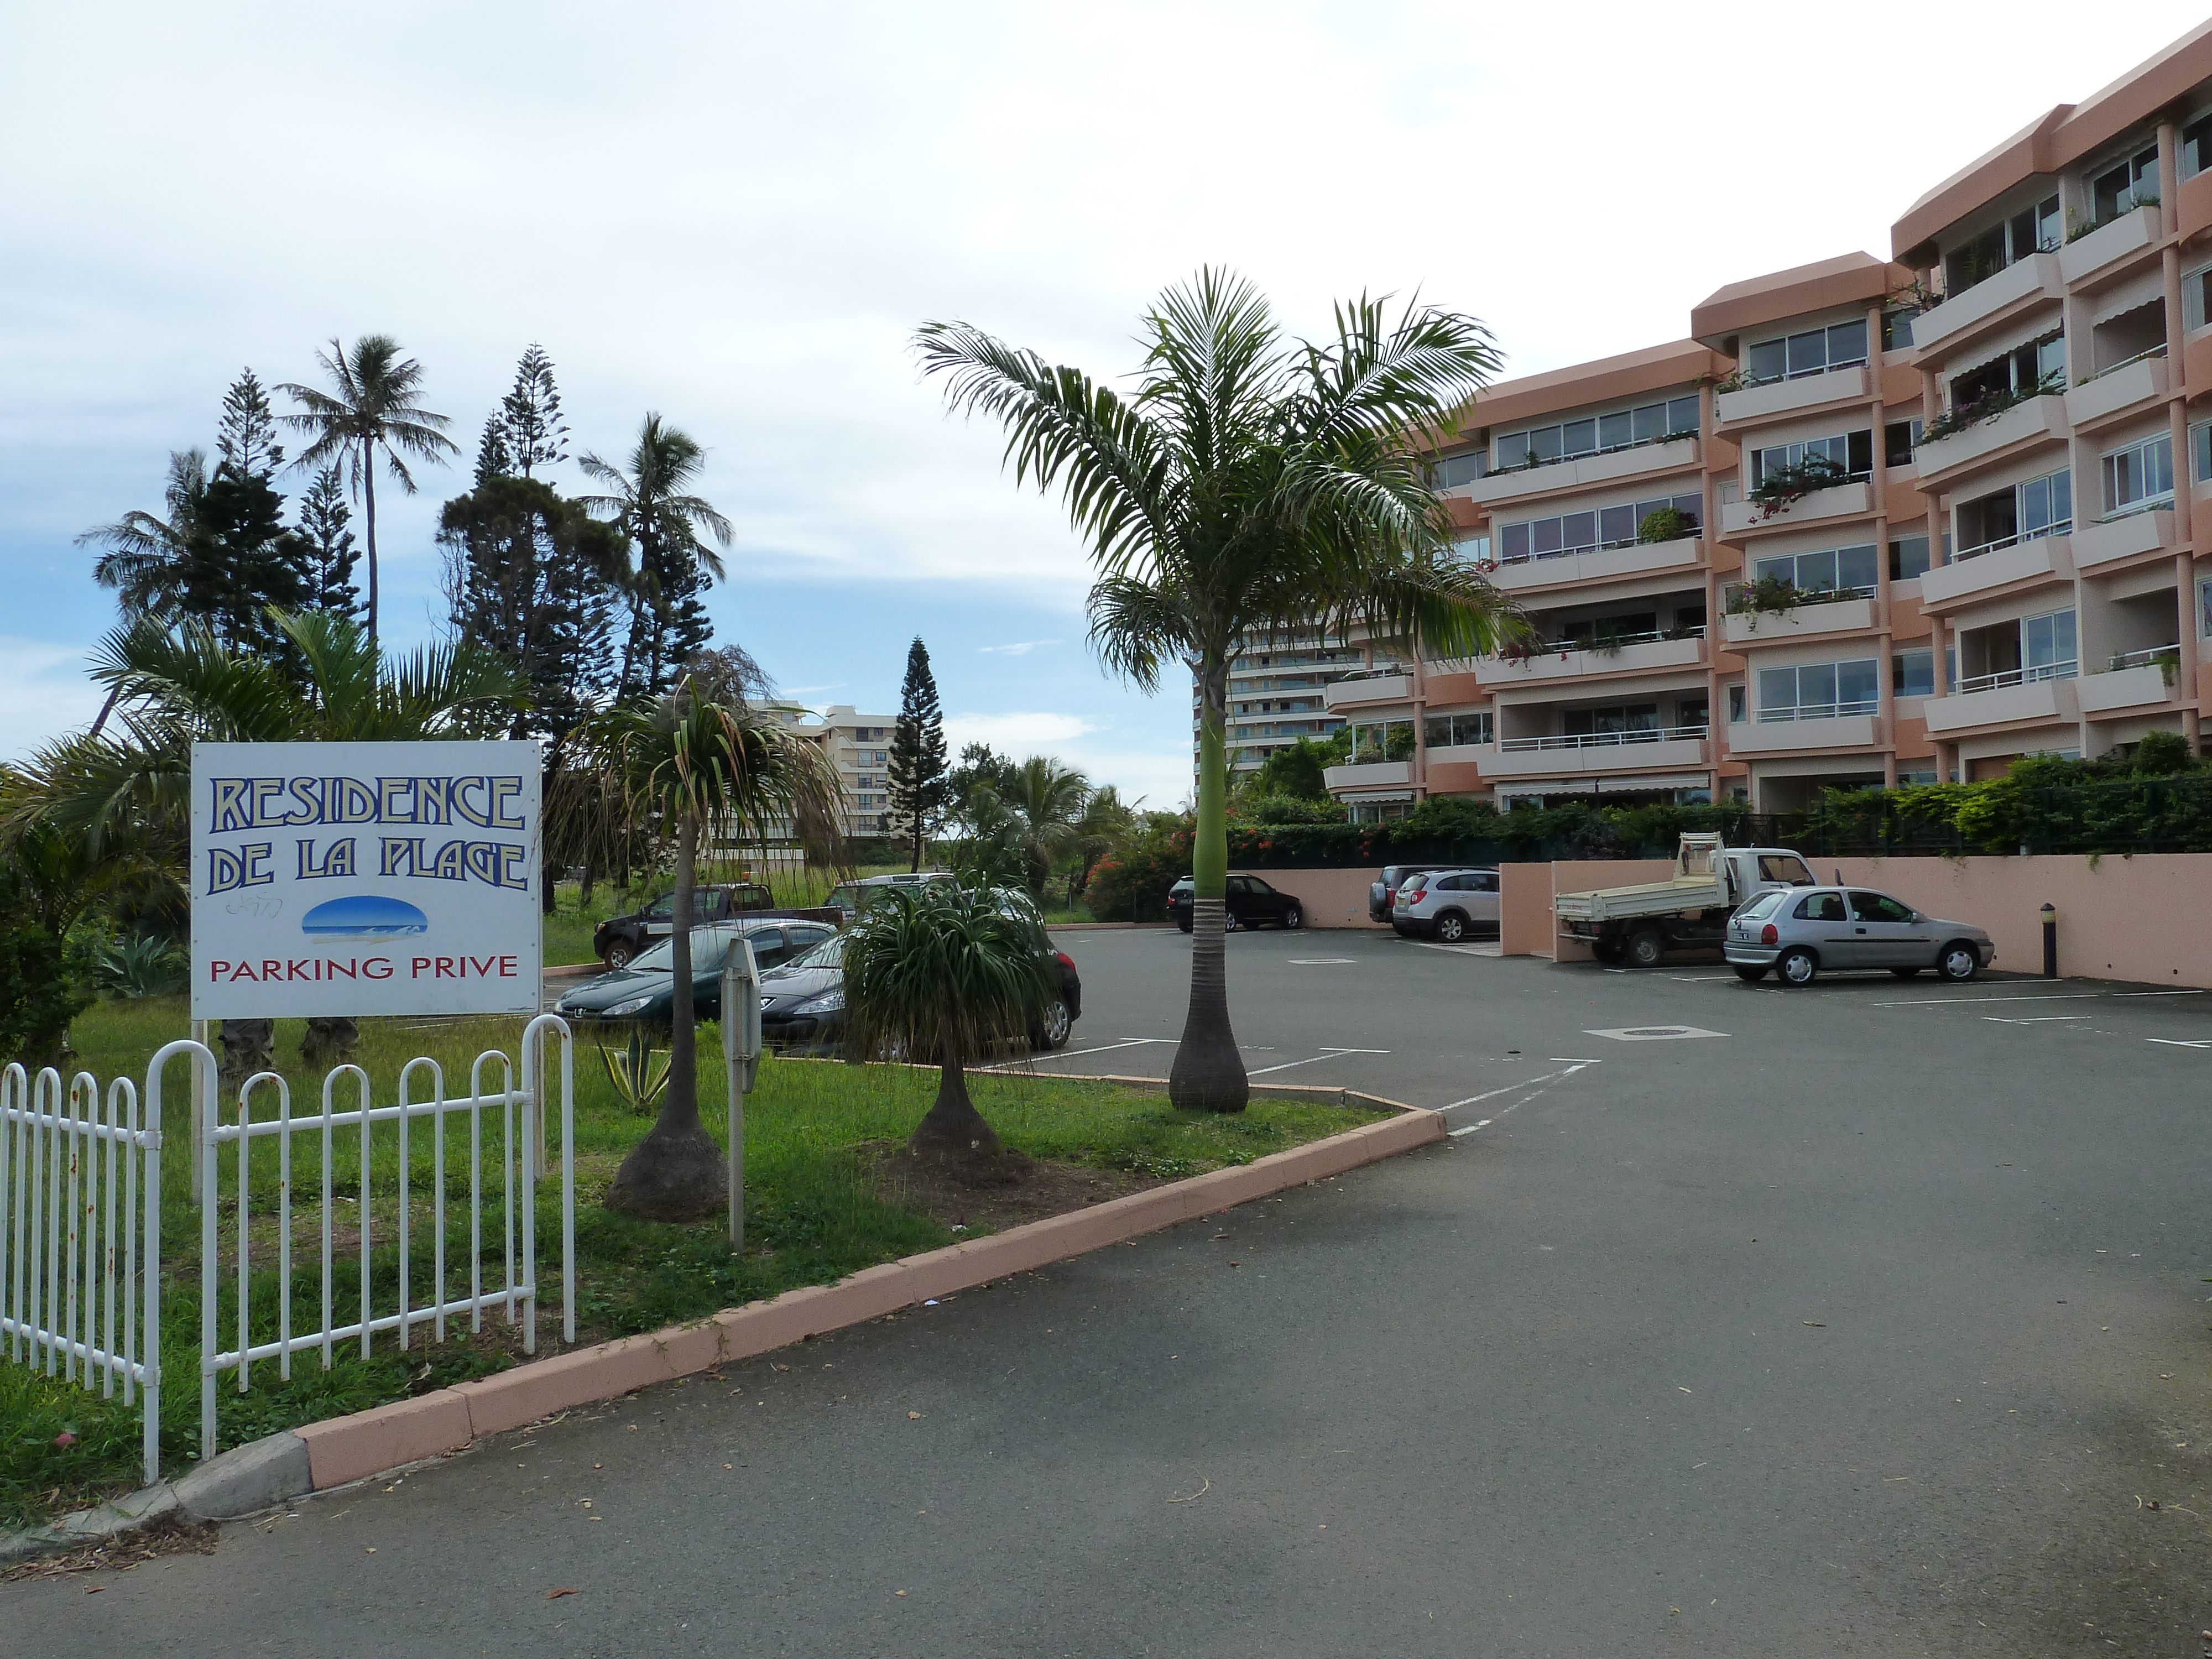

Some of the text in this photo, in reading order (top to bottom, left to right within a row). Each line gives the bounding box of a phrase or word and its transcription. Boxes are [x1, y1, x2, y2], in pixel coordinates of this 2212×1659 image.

[209, 776, 525, 834] RESIDENCE
[206, 837, 528, 895] DE LA PLAGE
[211, 955, 518, 982] PARKING PRIVE
